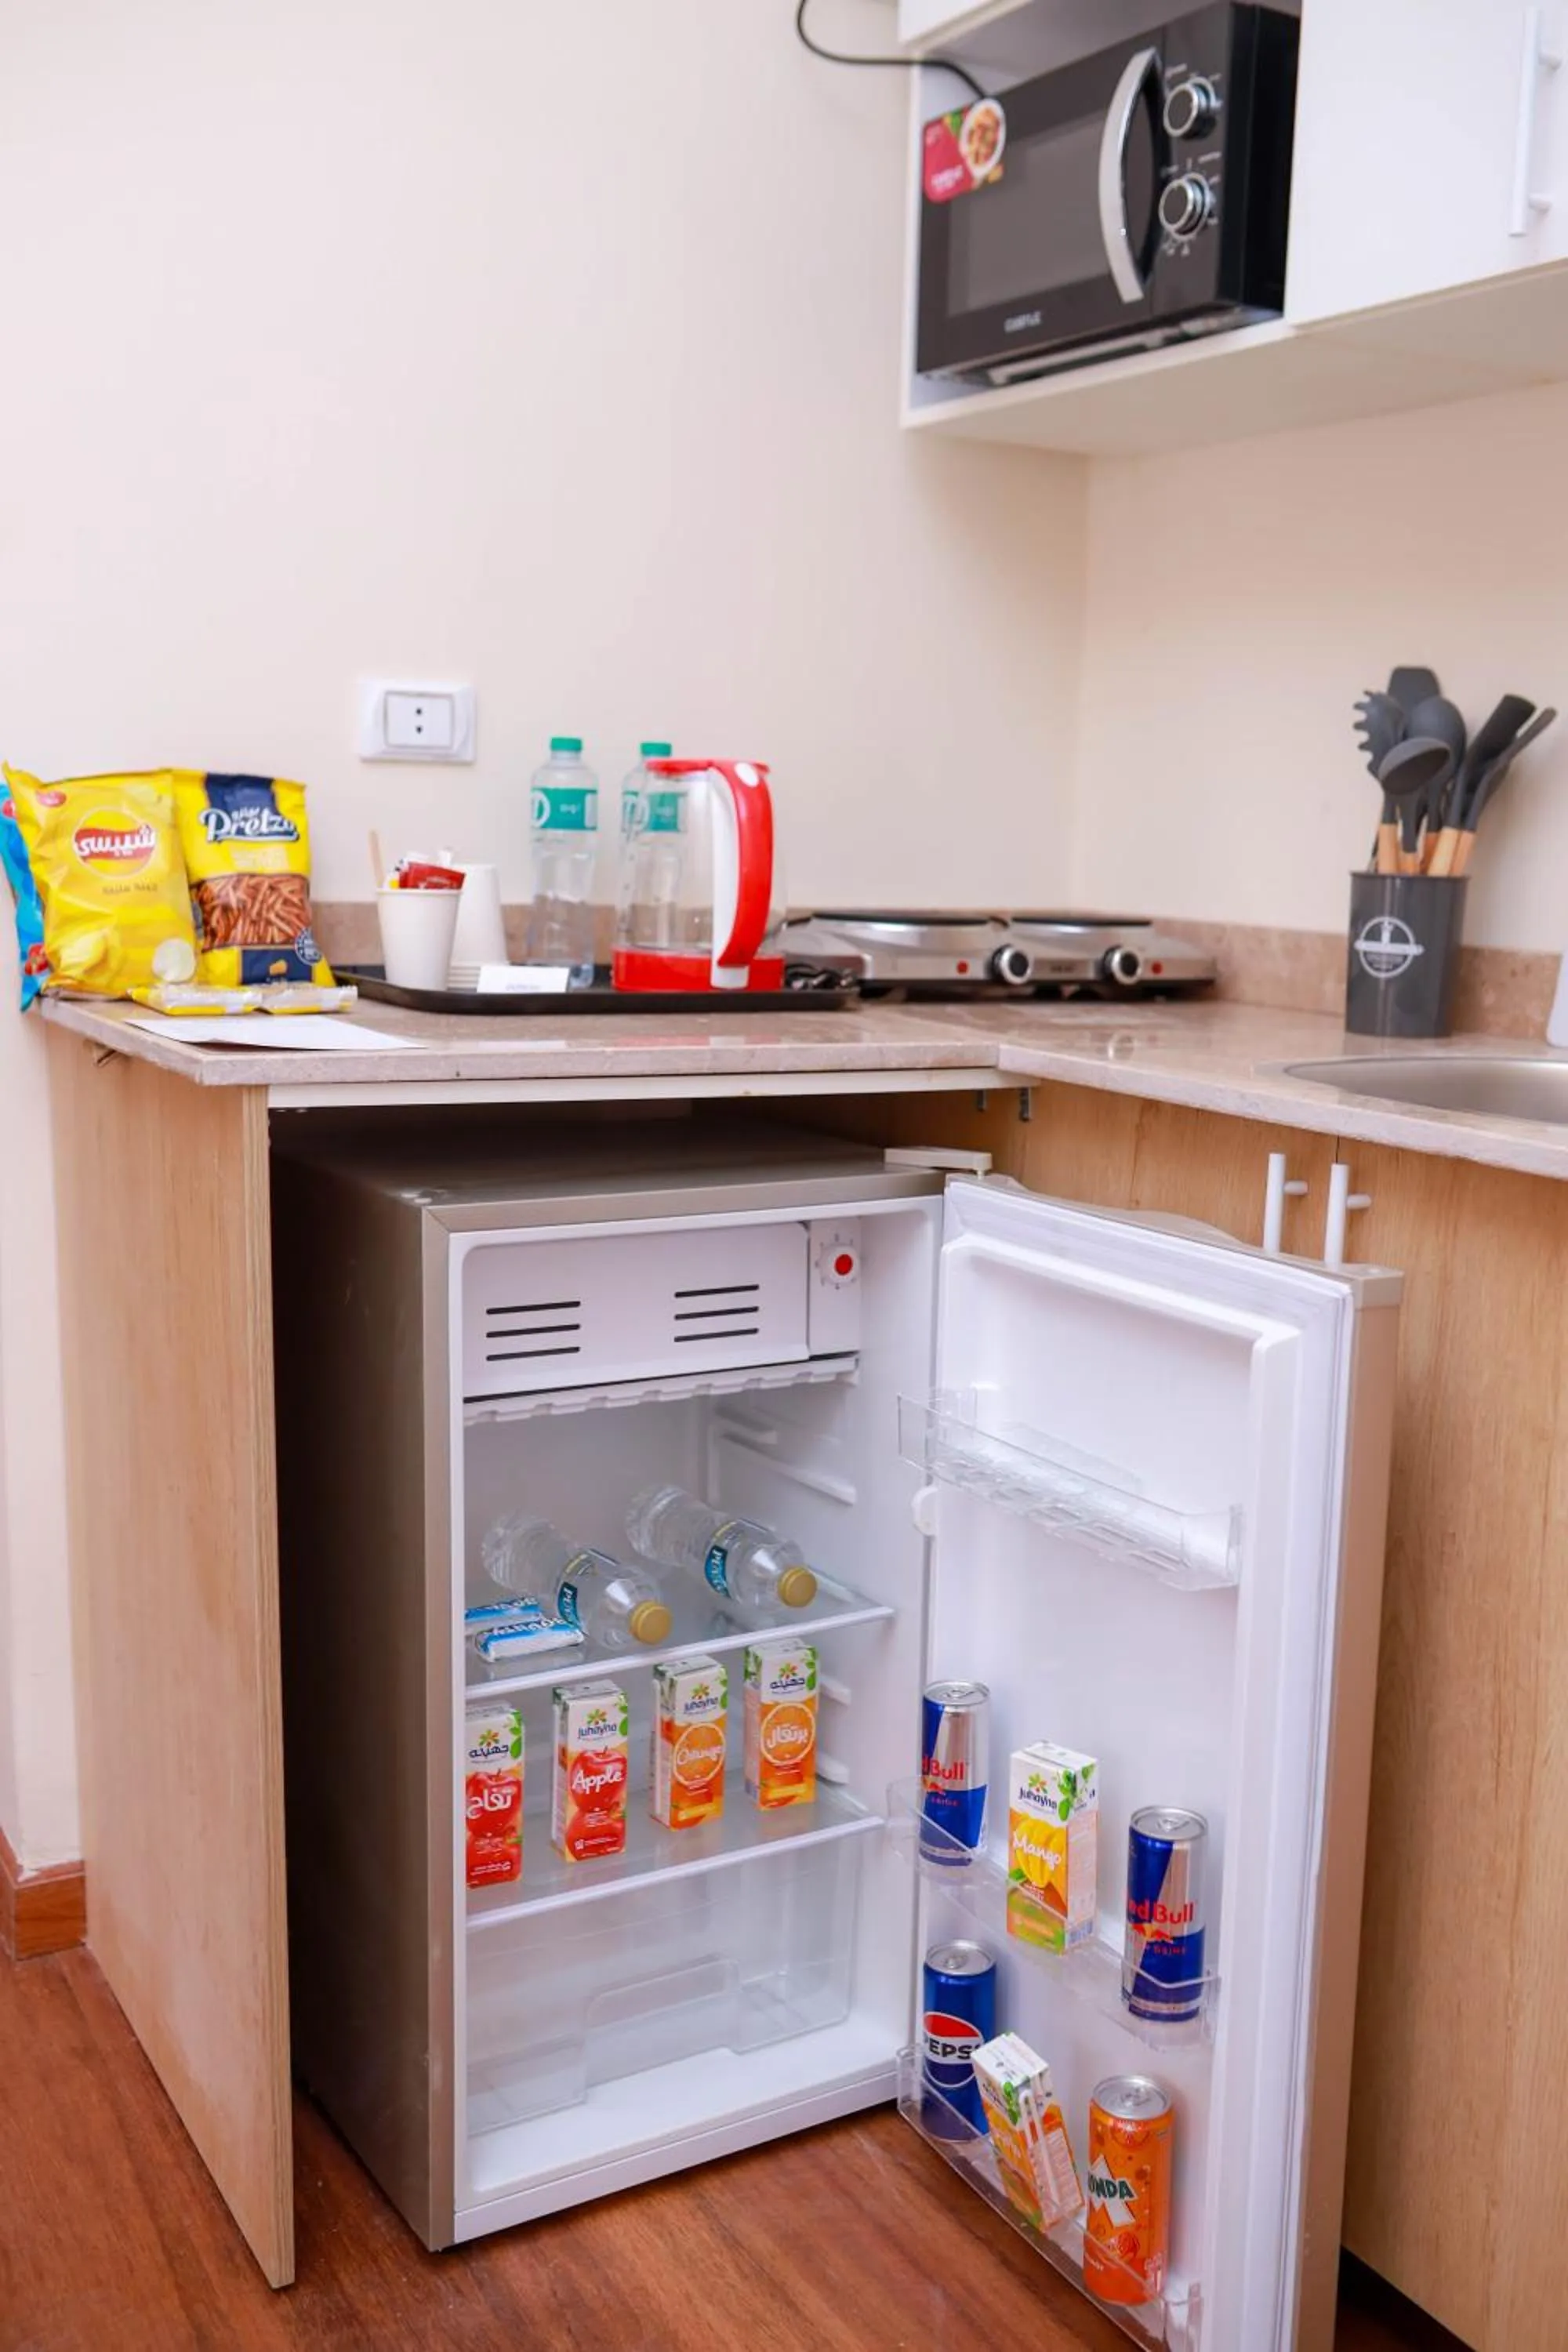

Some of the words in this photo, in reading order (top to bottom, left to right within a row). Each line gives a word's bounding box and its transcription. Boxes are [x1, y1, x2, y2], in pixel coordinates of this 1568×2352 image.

[572, 1766, 623, 1795] Apple
[931, 1759, 964, 1780] Bull
[466, 1786, 514, 1820] تفاح
[1012, 1832, 1062, 1871] Mango
[1127, 1899, 1150, 1920] ed
[1153, 1901, 1194, 1924] Bull
[928, 2038, 980, 2060] EPS
